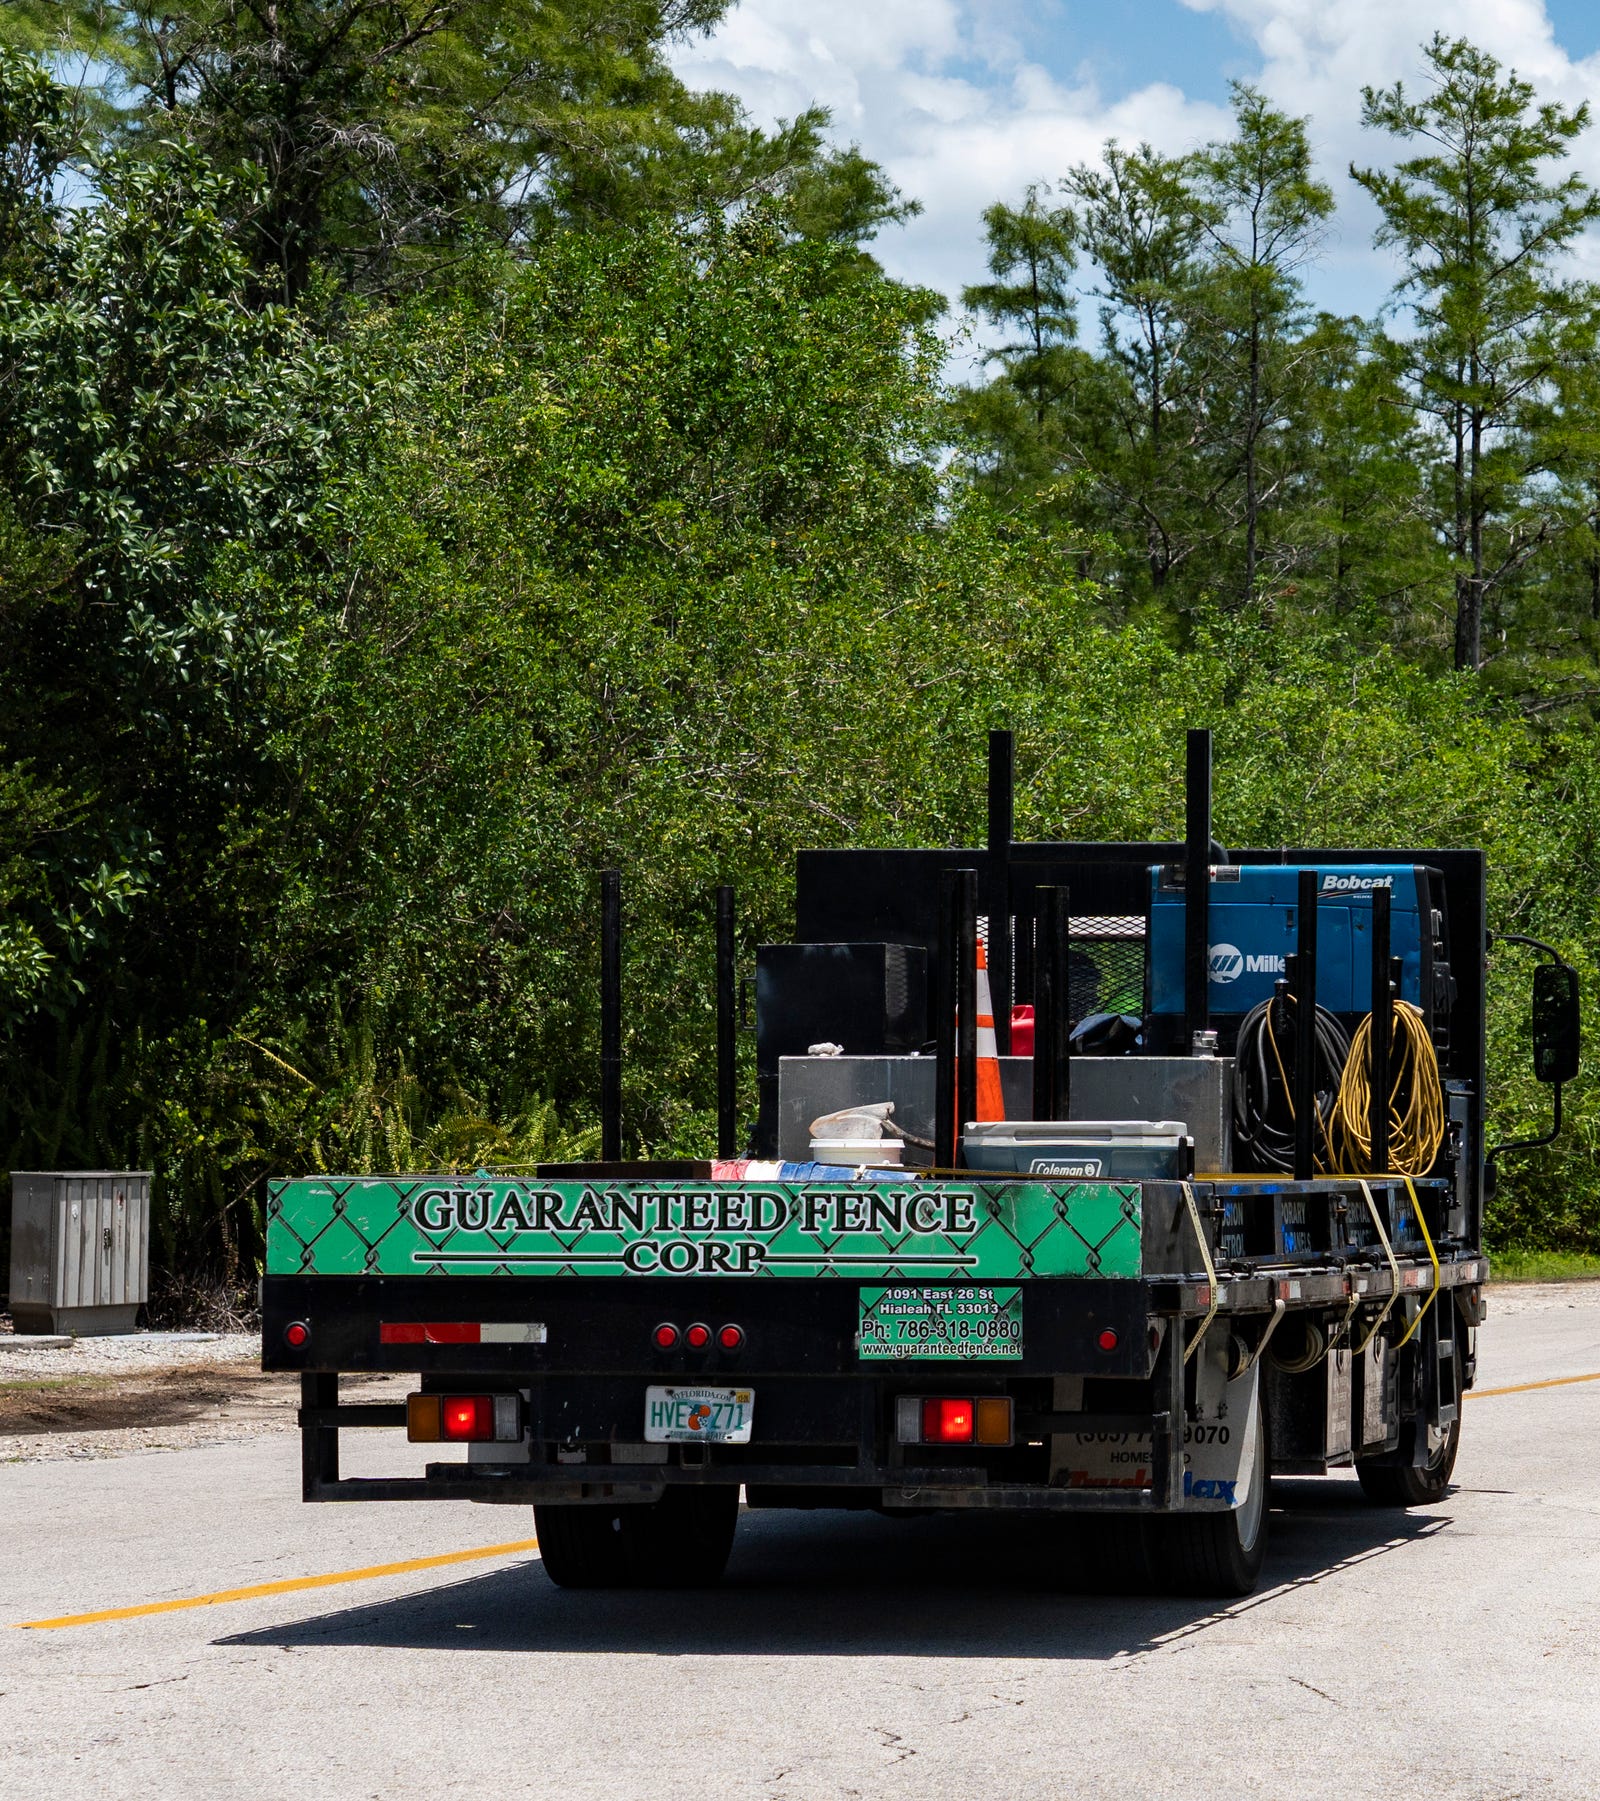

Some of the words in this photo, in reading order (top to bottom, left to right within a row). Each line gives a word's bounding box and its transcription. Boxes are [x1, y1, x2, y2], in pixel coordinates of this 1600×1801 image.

[1322, 875, 1394, 890] Bobcat
[1246, 955, 1286, 973] Mille
[1036, 1163, 1084, 1177] Coleman
[414, 1190, 788, 1232] GUARANTEED
[801, 1191, 977, 1233] FENCE
[624, 1240, 767, 1275] CORP
[886, 1289, 917, 1300] 1091
[922, 1289, 953, 1300] East
[957, 1289, 974, 1300] 26
[979, 1289, 994, 1300] St
[880, 1304, 932, 1314] Hialeah
[936, 1304, 953, 1314] FL
[957, 1304, 999, 1315] 33013
[861, 1320, 890, 1339] Ph:
[896, 1320, 1020, 1339] 786-318-0880
[862, 1341, 1022, 1357] www.guaranteedfence.net
[651, 1401, 688, 1428] HVE
